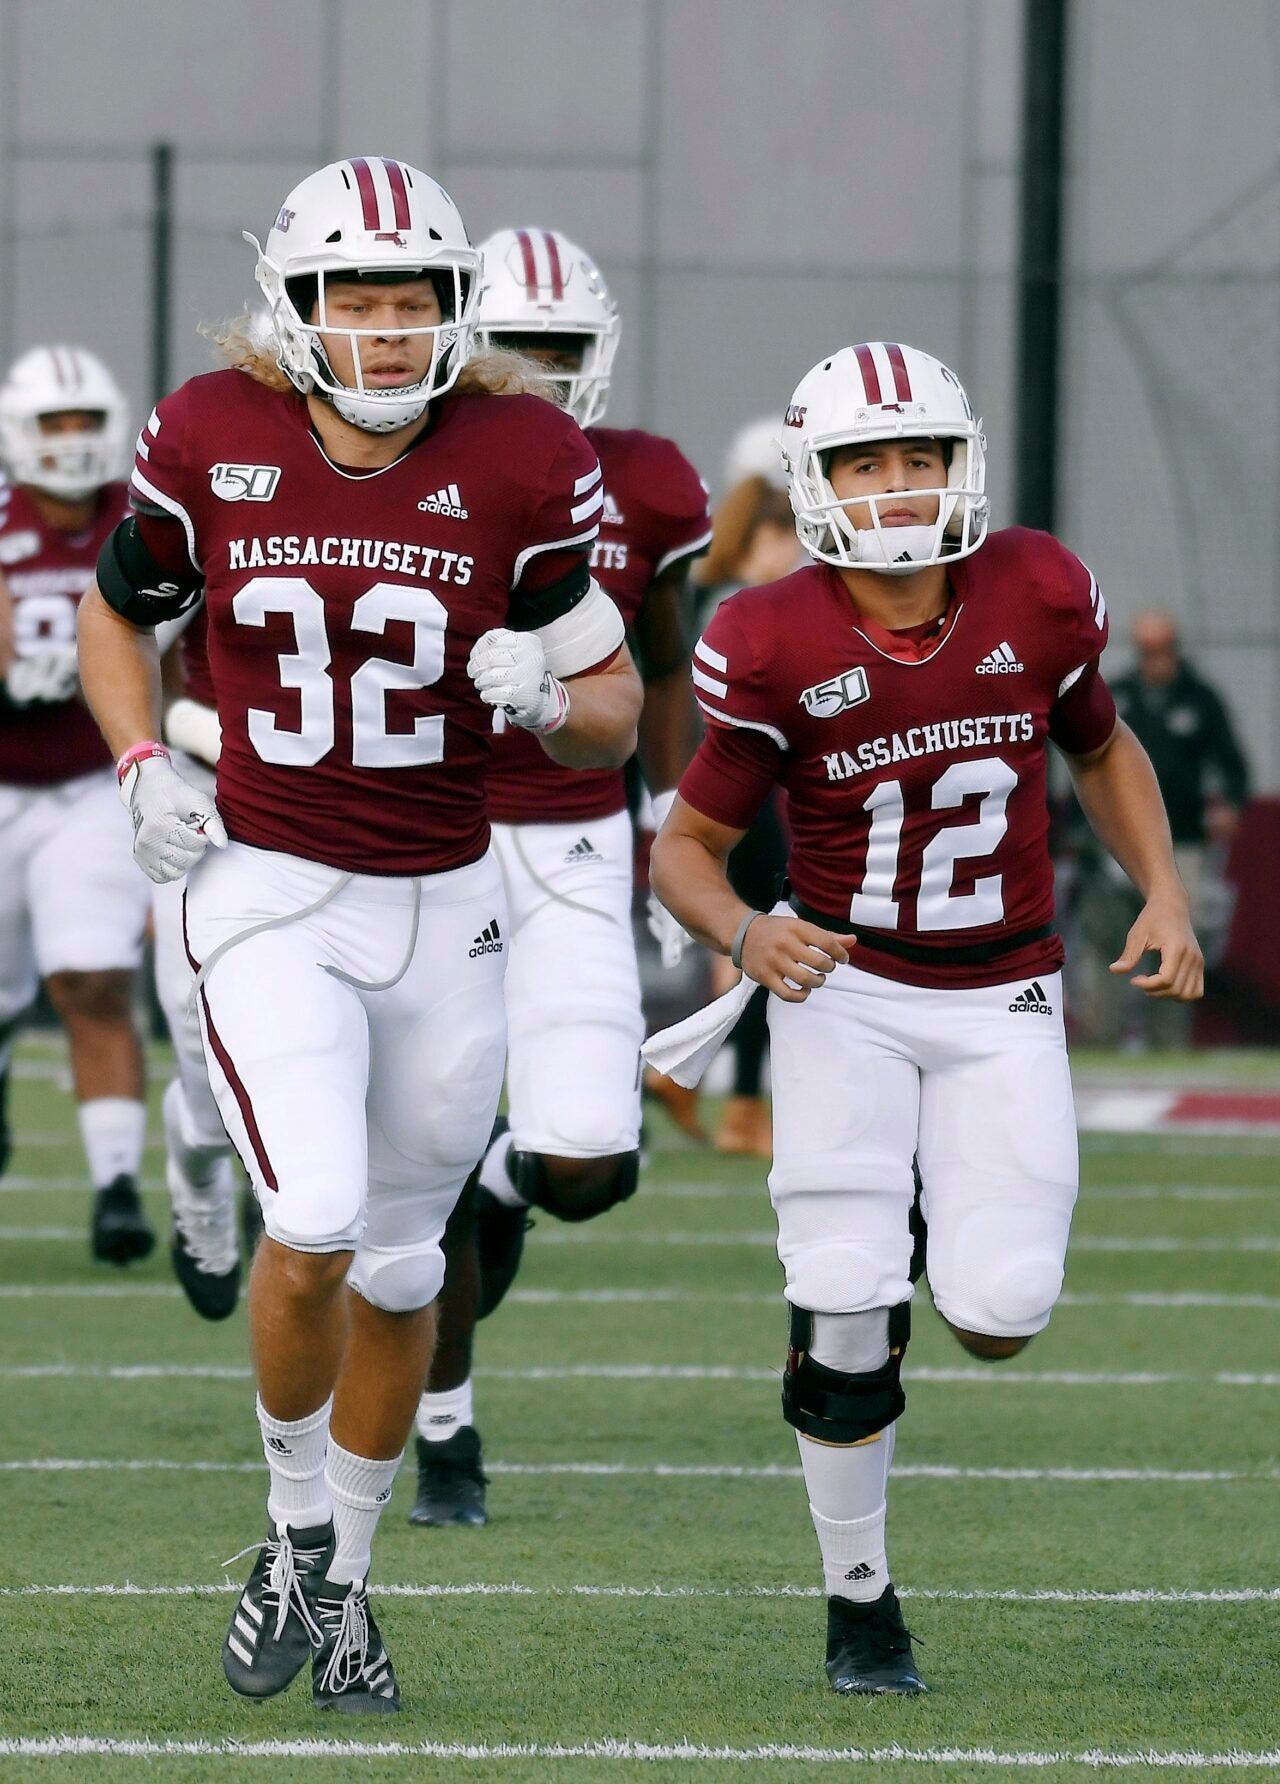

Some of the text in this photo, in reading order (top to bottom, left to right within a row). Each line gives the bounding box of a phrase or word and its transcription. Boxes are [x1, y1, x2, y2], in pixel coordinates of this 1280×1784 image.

[208, 463, 282, 502] 150
[417, 496, 469, 520] adidas
[229, 536, 474, 586] MASSACHUSETTS
[232, 577, 449, 768] 32
[975, 660, 1024, 675] adidas
[799, 666, 871, 718] 150
[822, 713, 1033, 781] MASSACHUSETTS
[850, 757, 1018, 931] 12
[468, 940, 503, 958] adidas
[1008, 1000, 1052, 1016] adidas
[844, 1570, 876, 1580] adidas
